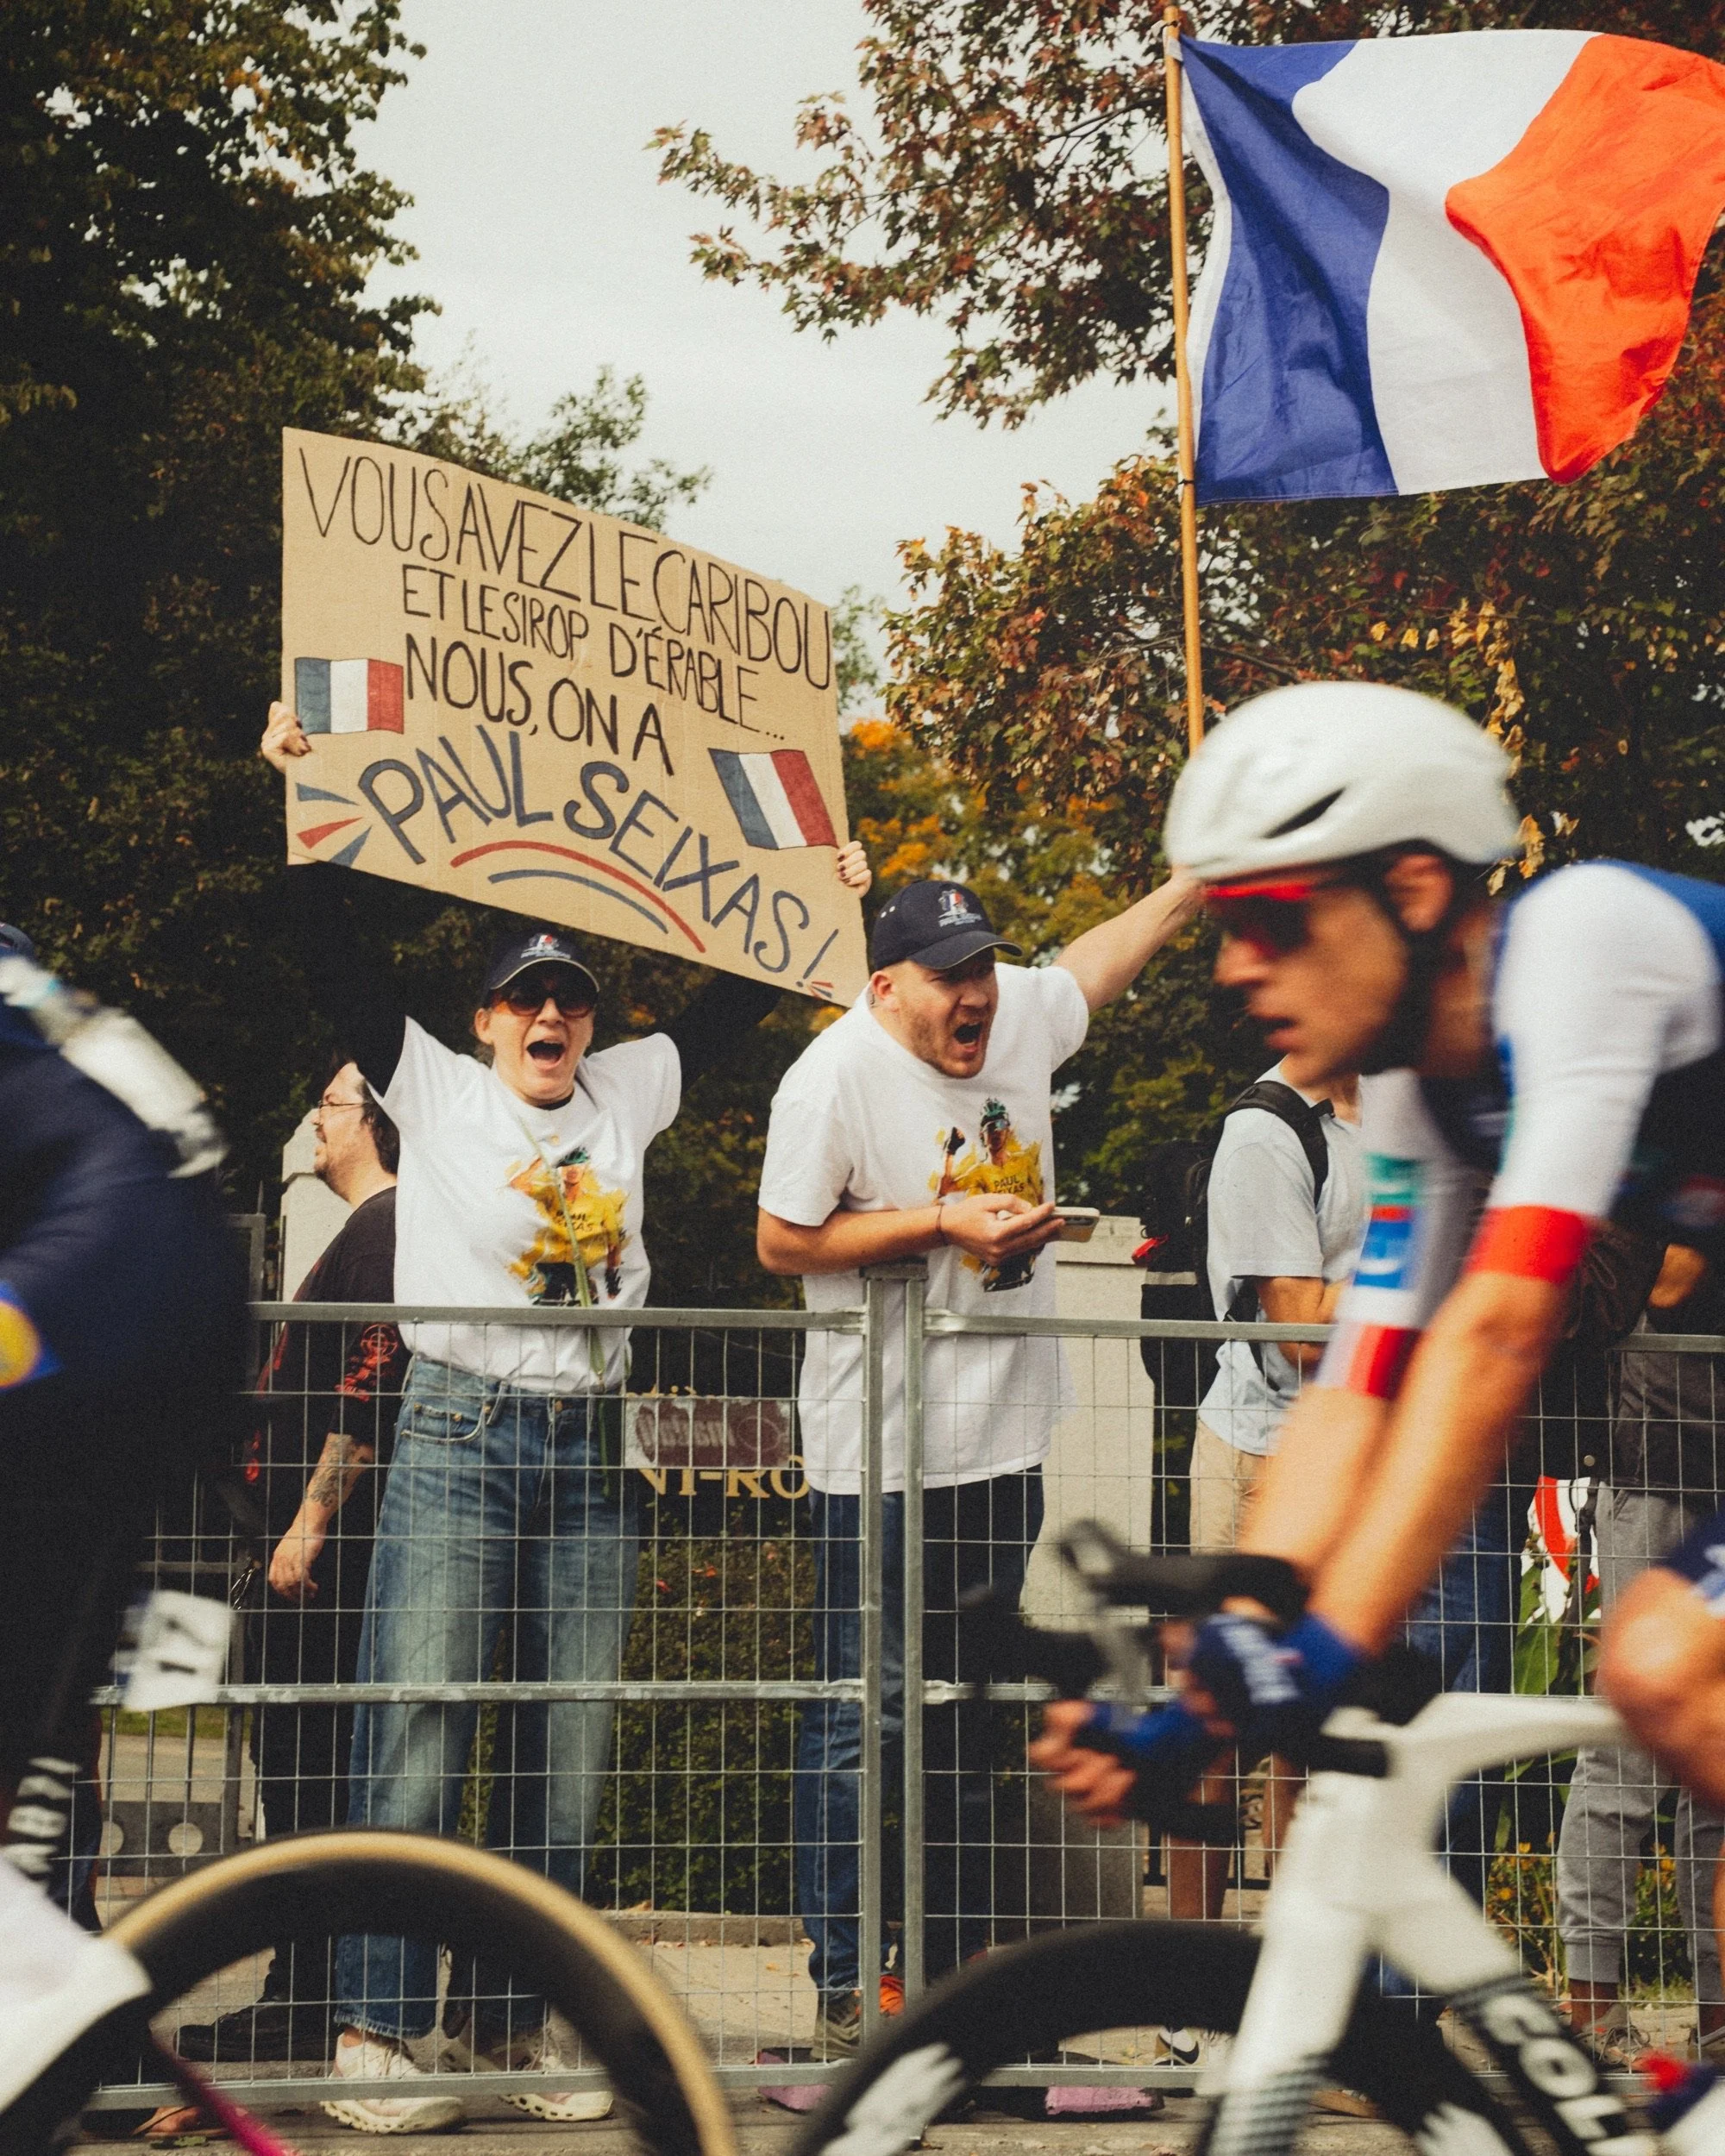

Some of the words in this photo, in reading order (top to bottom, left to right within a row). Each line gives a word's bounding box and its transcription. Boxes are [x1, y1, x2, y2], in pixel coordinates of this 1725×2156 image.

[298, 447, 450, 562] VOUS
[455, 481, 584, 602] AVEZ
[588, 521, 658, 623] LE
[652, 549, 831, 691] CARIBOU
[402, 563, 455, 621] ET
[461, 579, 502, 641] LE
[501, 591, 590, 661] SIROP
[405, 632, 539, 736] NOUS,
[548, 677, 619, 755] ON
[632, 702, 675, 777] A
[357, 724, 554, 864] PAUL
